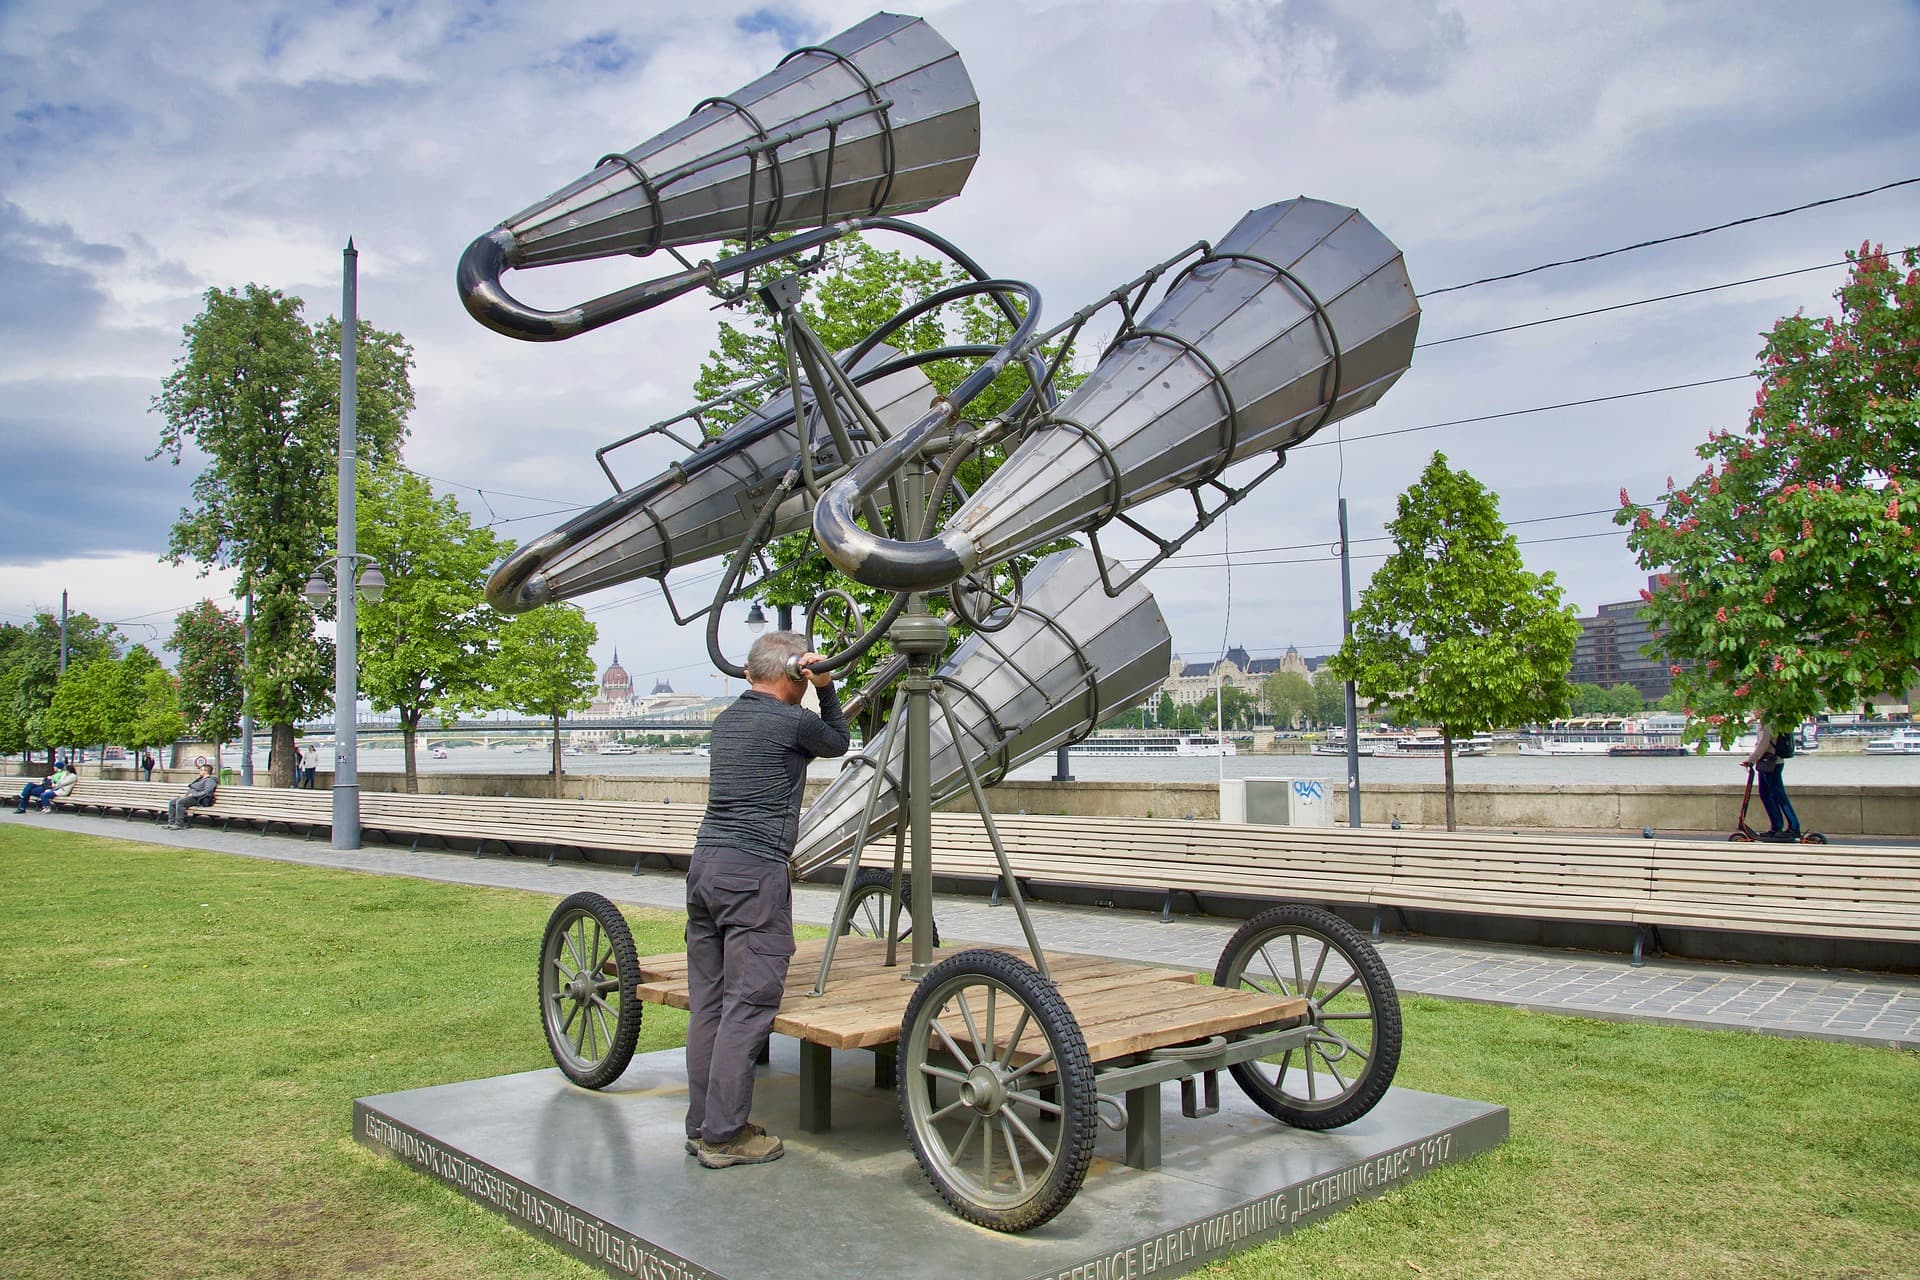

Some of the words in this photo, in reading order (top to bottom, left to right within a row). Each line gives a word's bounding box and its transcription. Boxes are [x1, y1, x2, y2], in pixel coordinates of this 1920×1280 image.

[365, 1111, 439, 1174] LÉGITÁMADÁSOK
[440, 1152, 518, 1215] KISZŰRÉSÉHEZ
[520, 1190, 585, 1248] HASZNÁLT
[586, 1221, 707, 1280] FÜLELŐKÉSZ
[1142, 1225, 1200, 1276] EARLY
[1202, 1194, 1287, 1252] WARNING
[1419, 1133, 1452, 1168] 1917
